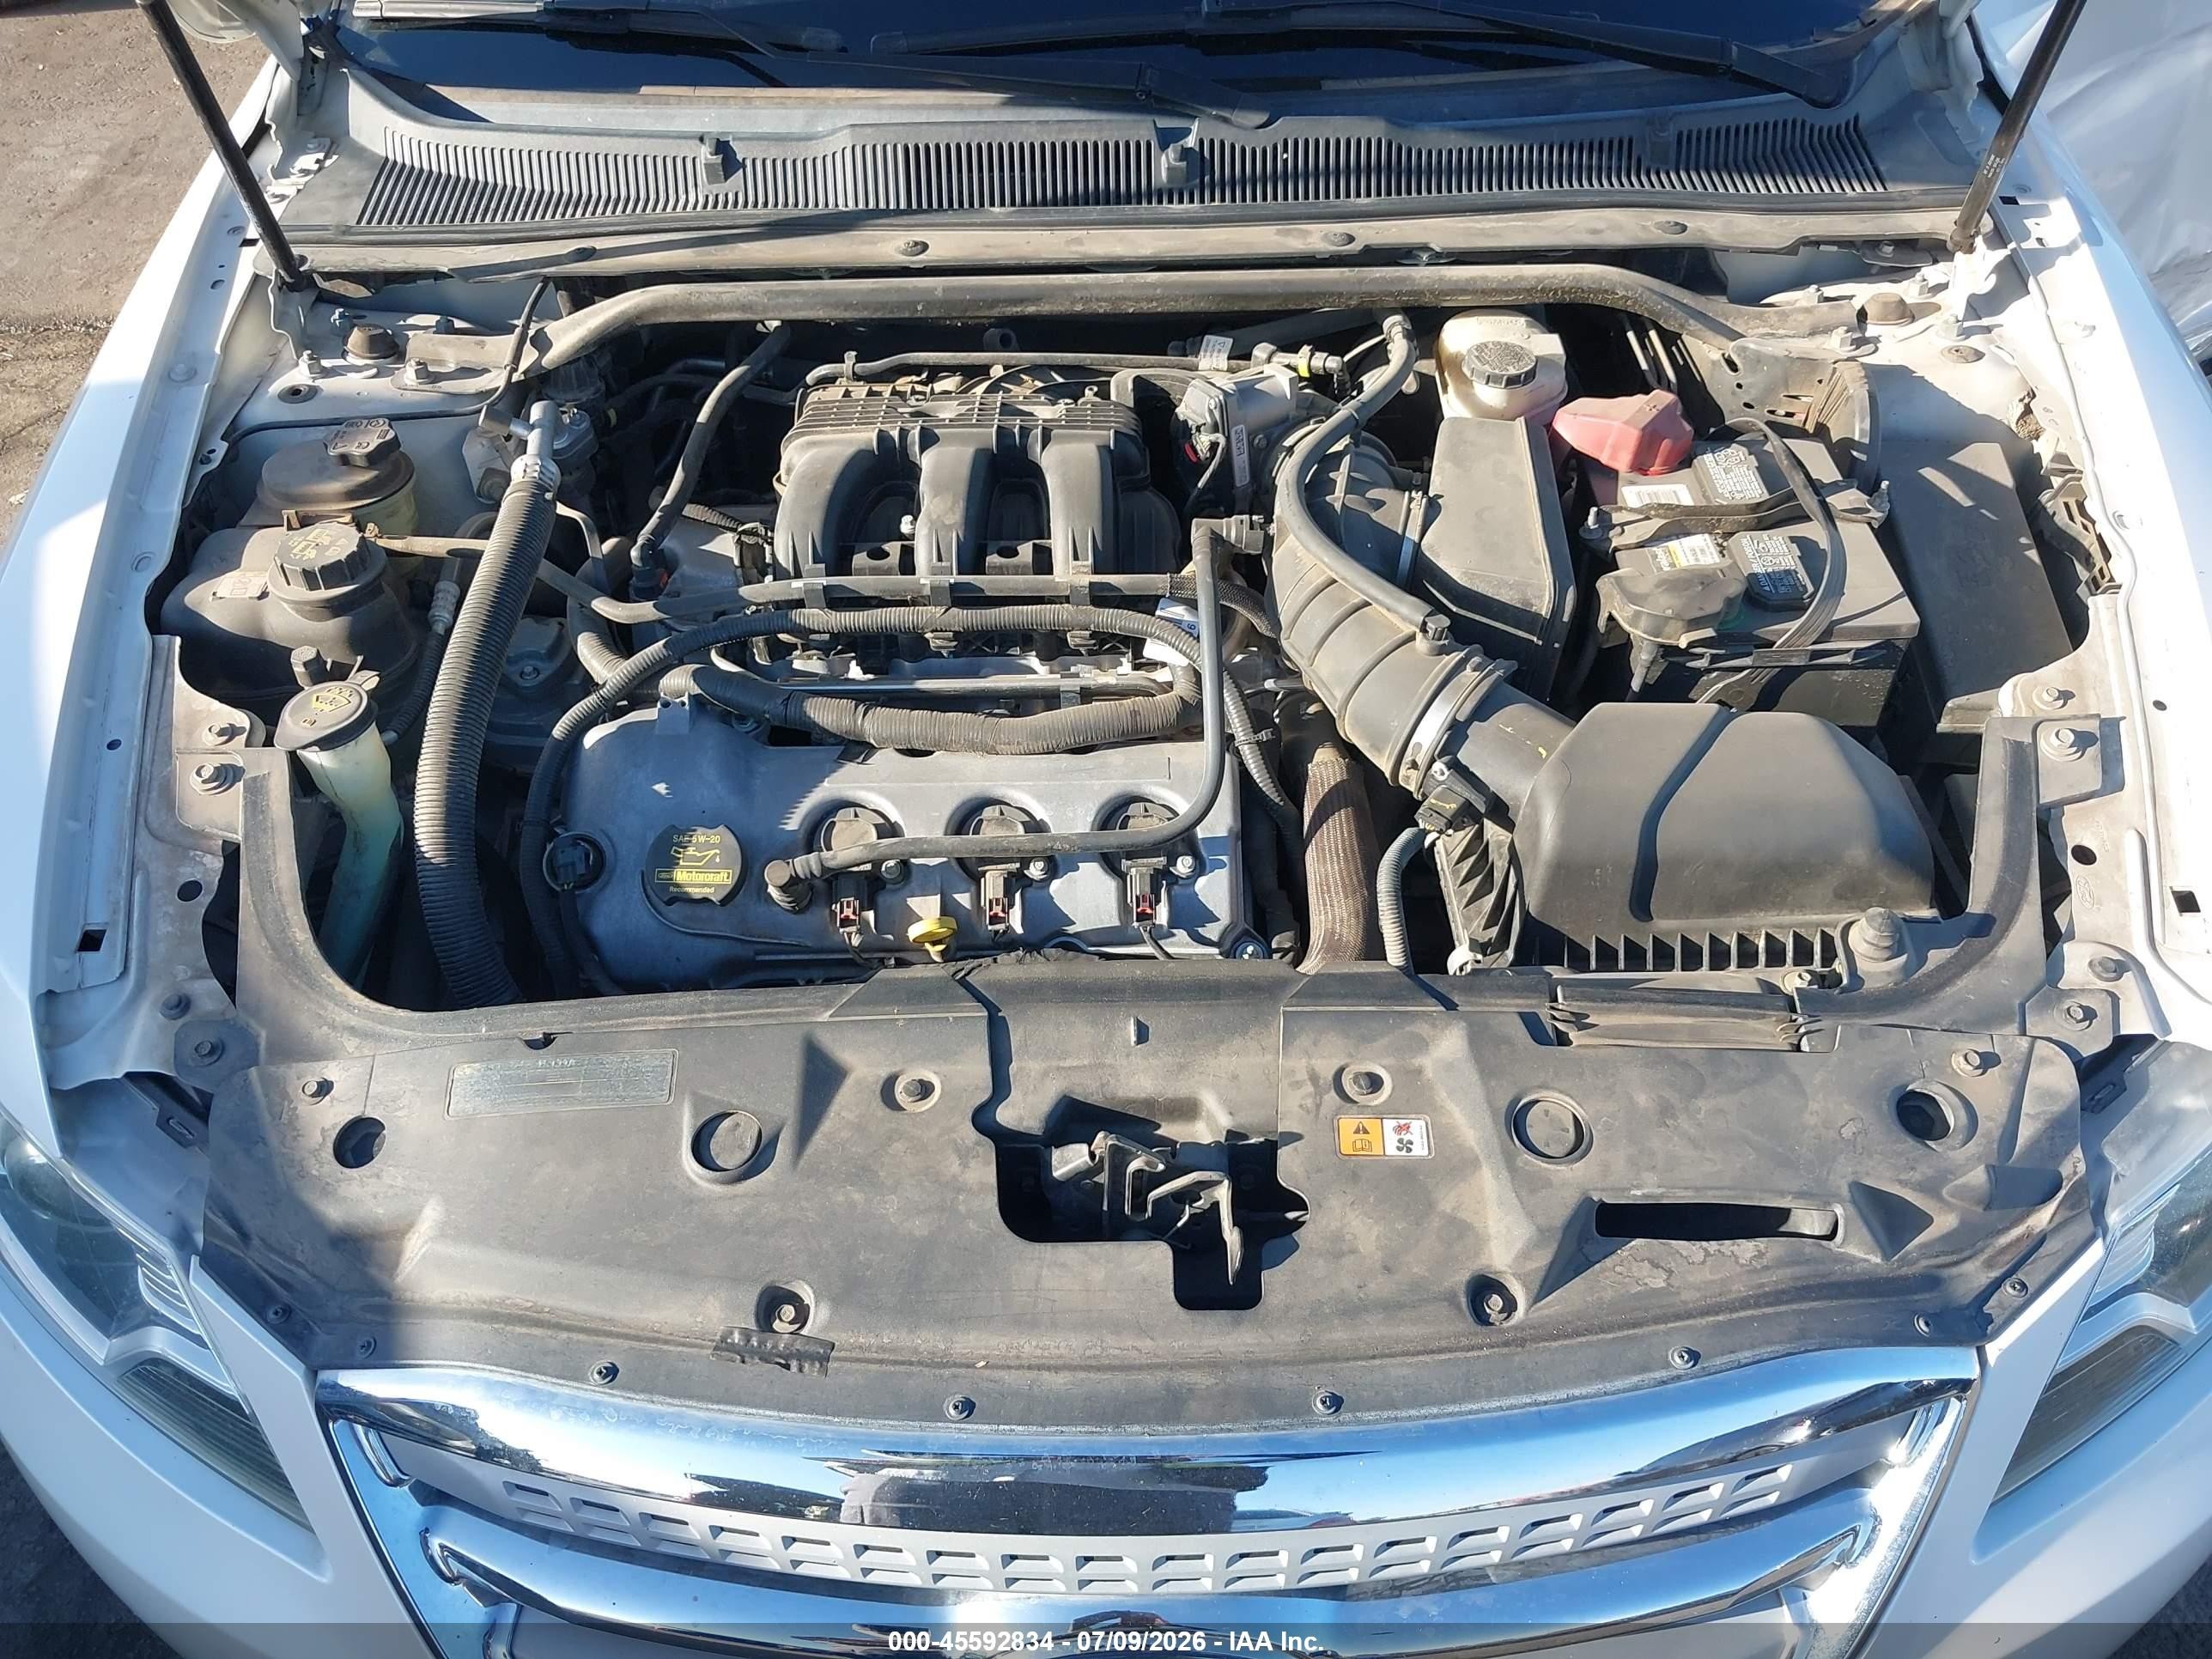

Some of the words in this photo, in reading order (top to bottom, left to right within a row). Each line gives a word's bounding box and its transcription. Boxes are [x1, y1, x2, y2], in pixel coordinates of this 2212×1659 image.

[672, 834, 690, 843] SAE
[691, 835, 721, 844] 5W-20
[676, 871, 729, 883] Motorcraft
